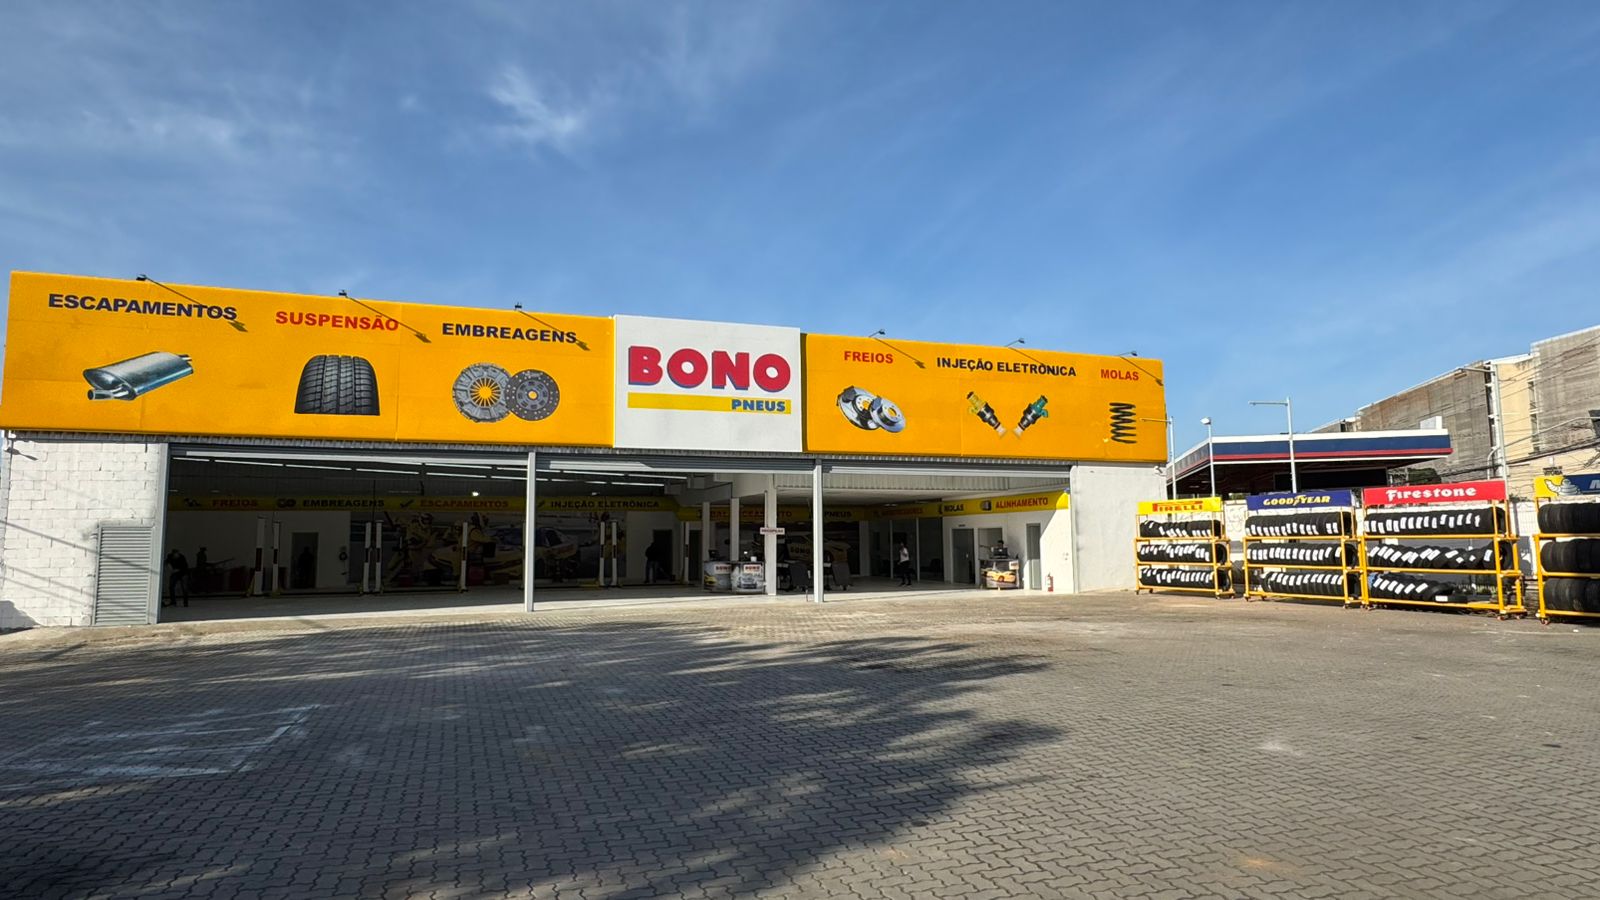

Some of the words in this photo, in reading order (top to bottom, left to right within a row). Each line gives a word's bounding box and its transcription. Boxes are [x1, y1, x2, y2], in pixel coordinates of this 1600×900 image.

[48, 293, 238, 321] ESCAPAMENTOS
[275, 311, 399, 331] SUSPENSÃO
[442, 323, 577, 344] EMBREAGENS
[844, 351, 894, 364] FREIOS
[628, 346, 791, 393] BONO
[937, 357, 993, 372] INJEÇÃO
[997, 361, 1077, 376] ELETRÔNICA
[1100, 368, 1139, 381] MOLAS
[730, 398, 786, 413] PNEUS
[1263, 494, 1331, 506] GOODYEAR
[1386, 487, 1476, 501] Firestone
[212, 499, 257, 507] FREIOS
[303, 499, 385, 507] EMBREAGENS
[420, 500, 508, 509] ESCAPAMENTOS
[551, 500, 594, 510] INJEÇÃO
[597, 501, 660, 509] ELETRÔNICA
[995, 497, 1048, 509] ALINHAMENTO
[1152, 500, 1203, 512] PIRELLI
